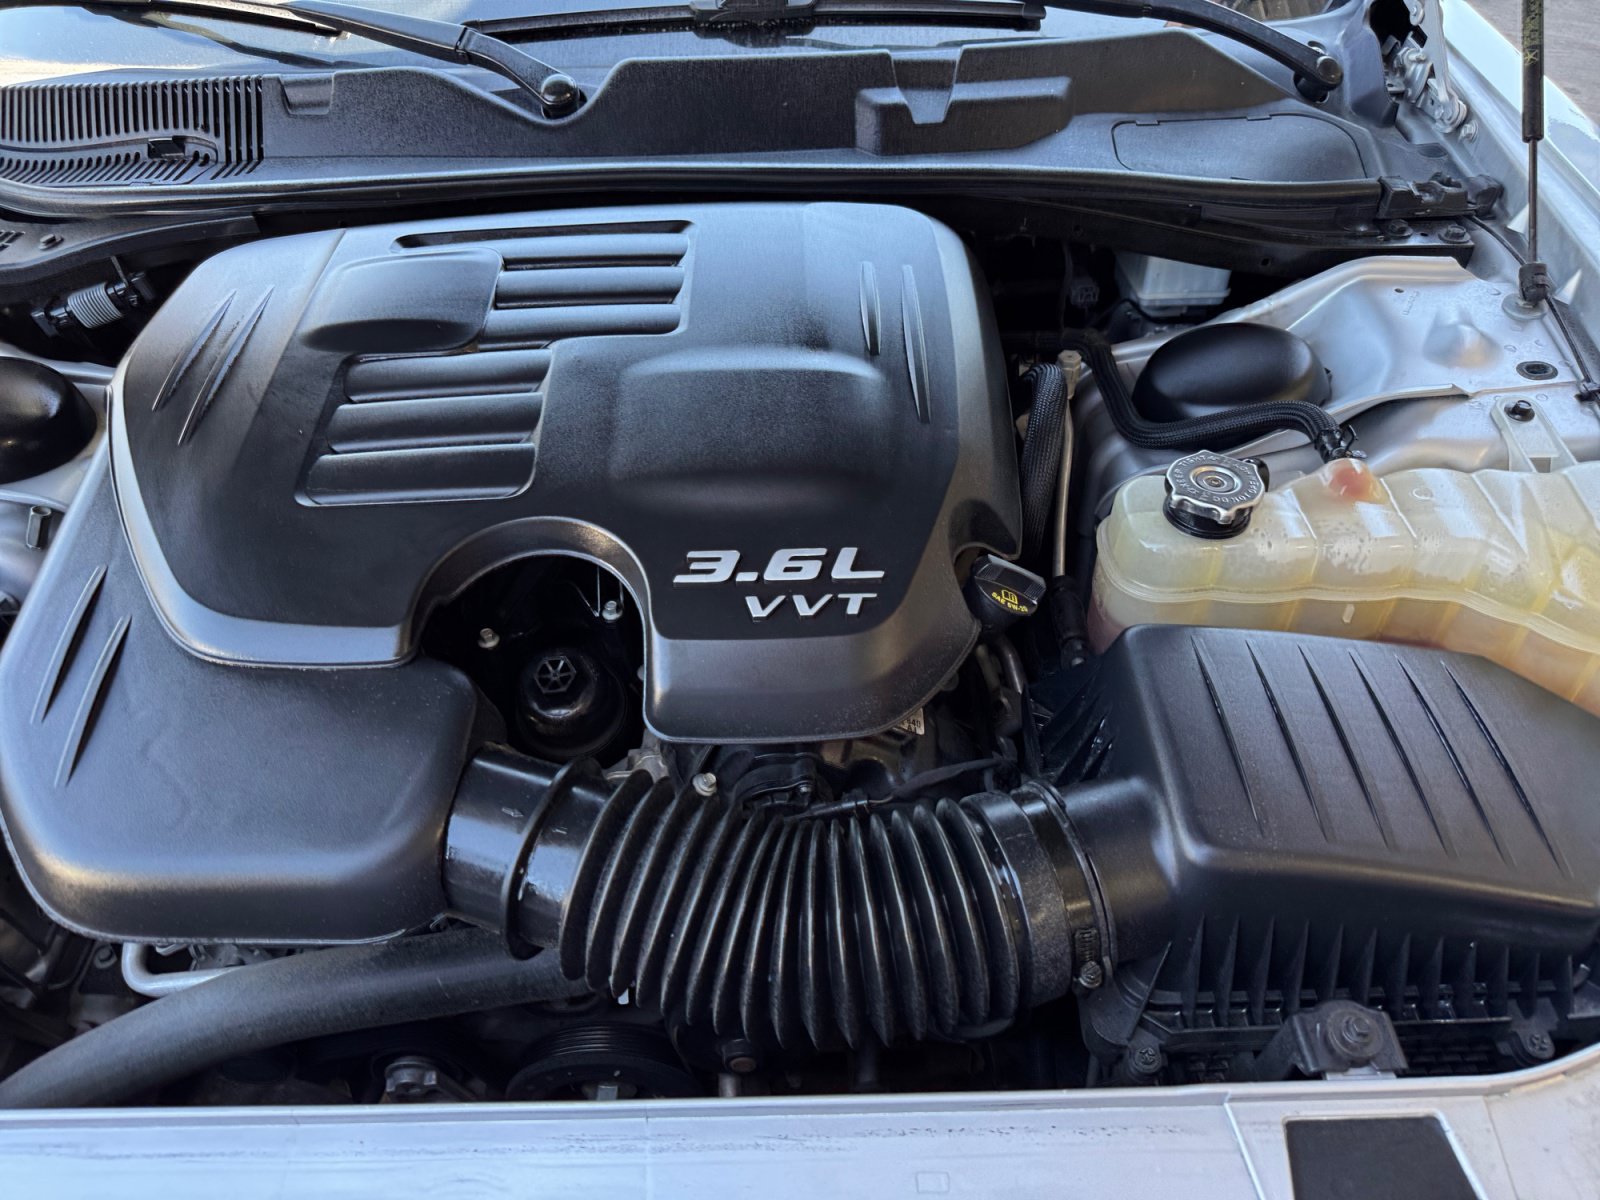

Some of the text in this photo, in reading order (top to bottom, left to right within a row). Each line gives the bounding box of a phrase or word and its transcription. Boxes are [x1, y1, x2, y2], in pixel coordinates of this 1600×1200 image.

[1174, 469, 1190, 488] KEEP
[673, 547, 885, 586] 3.6L
[745, 593, 877, 620] VVT
